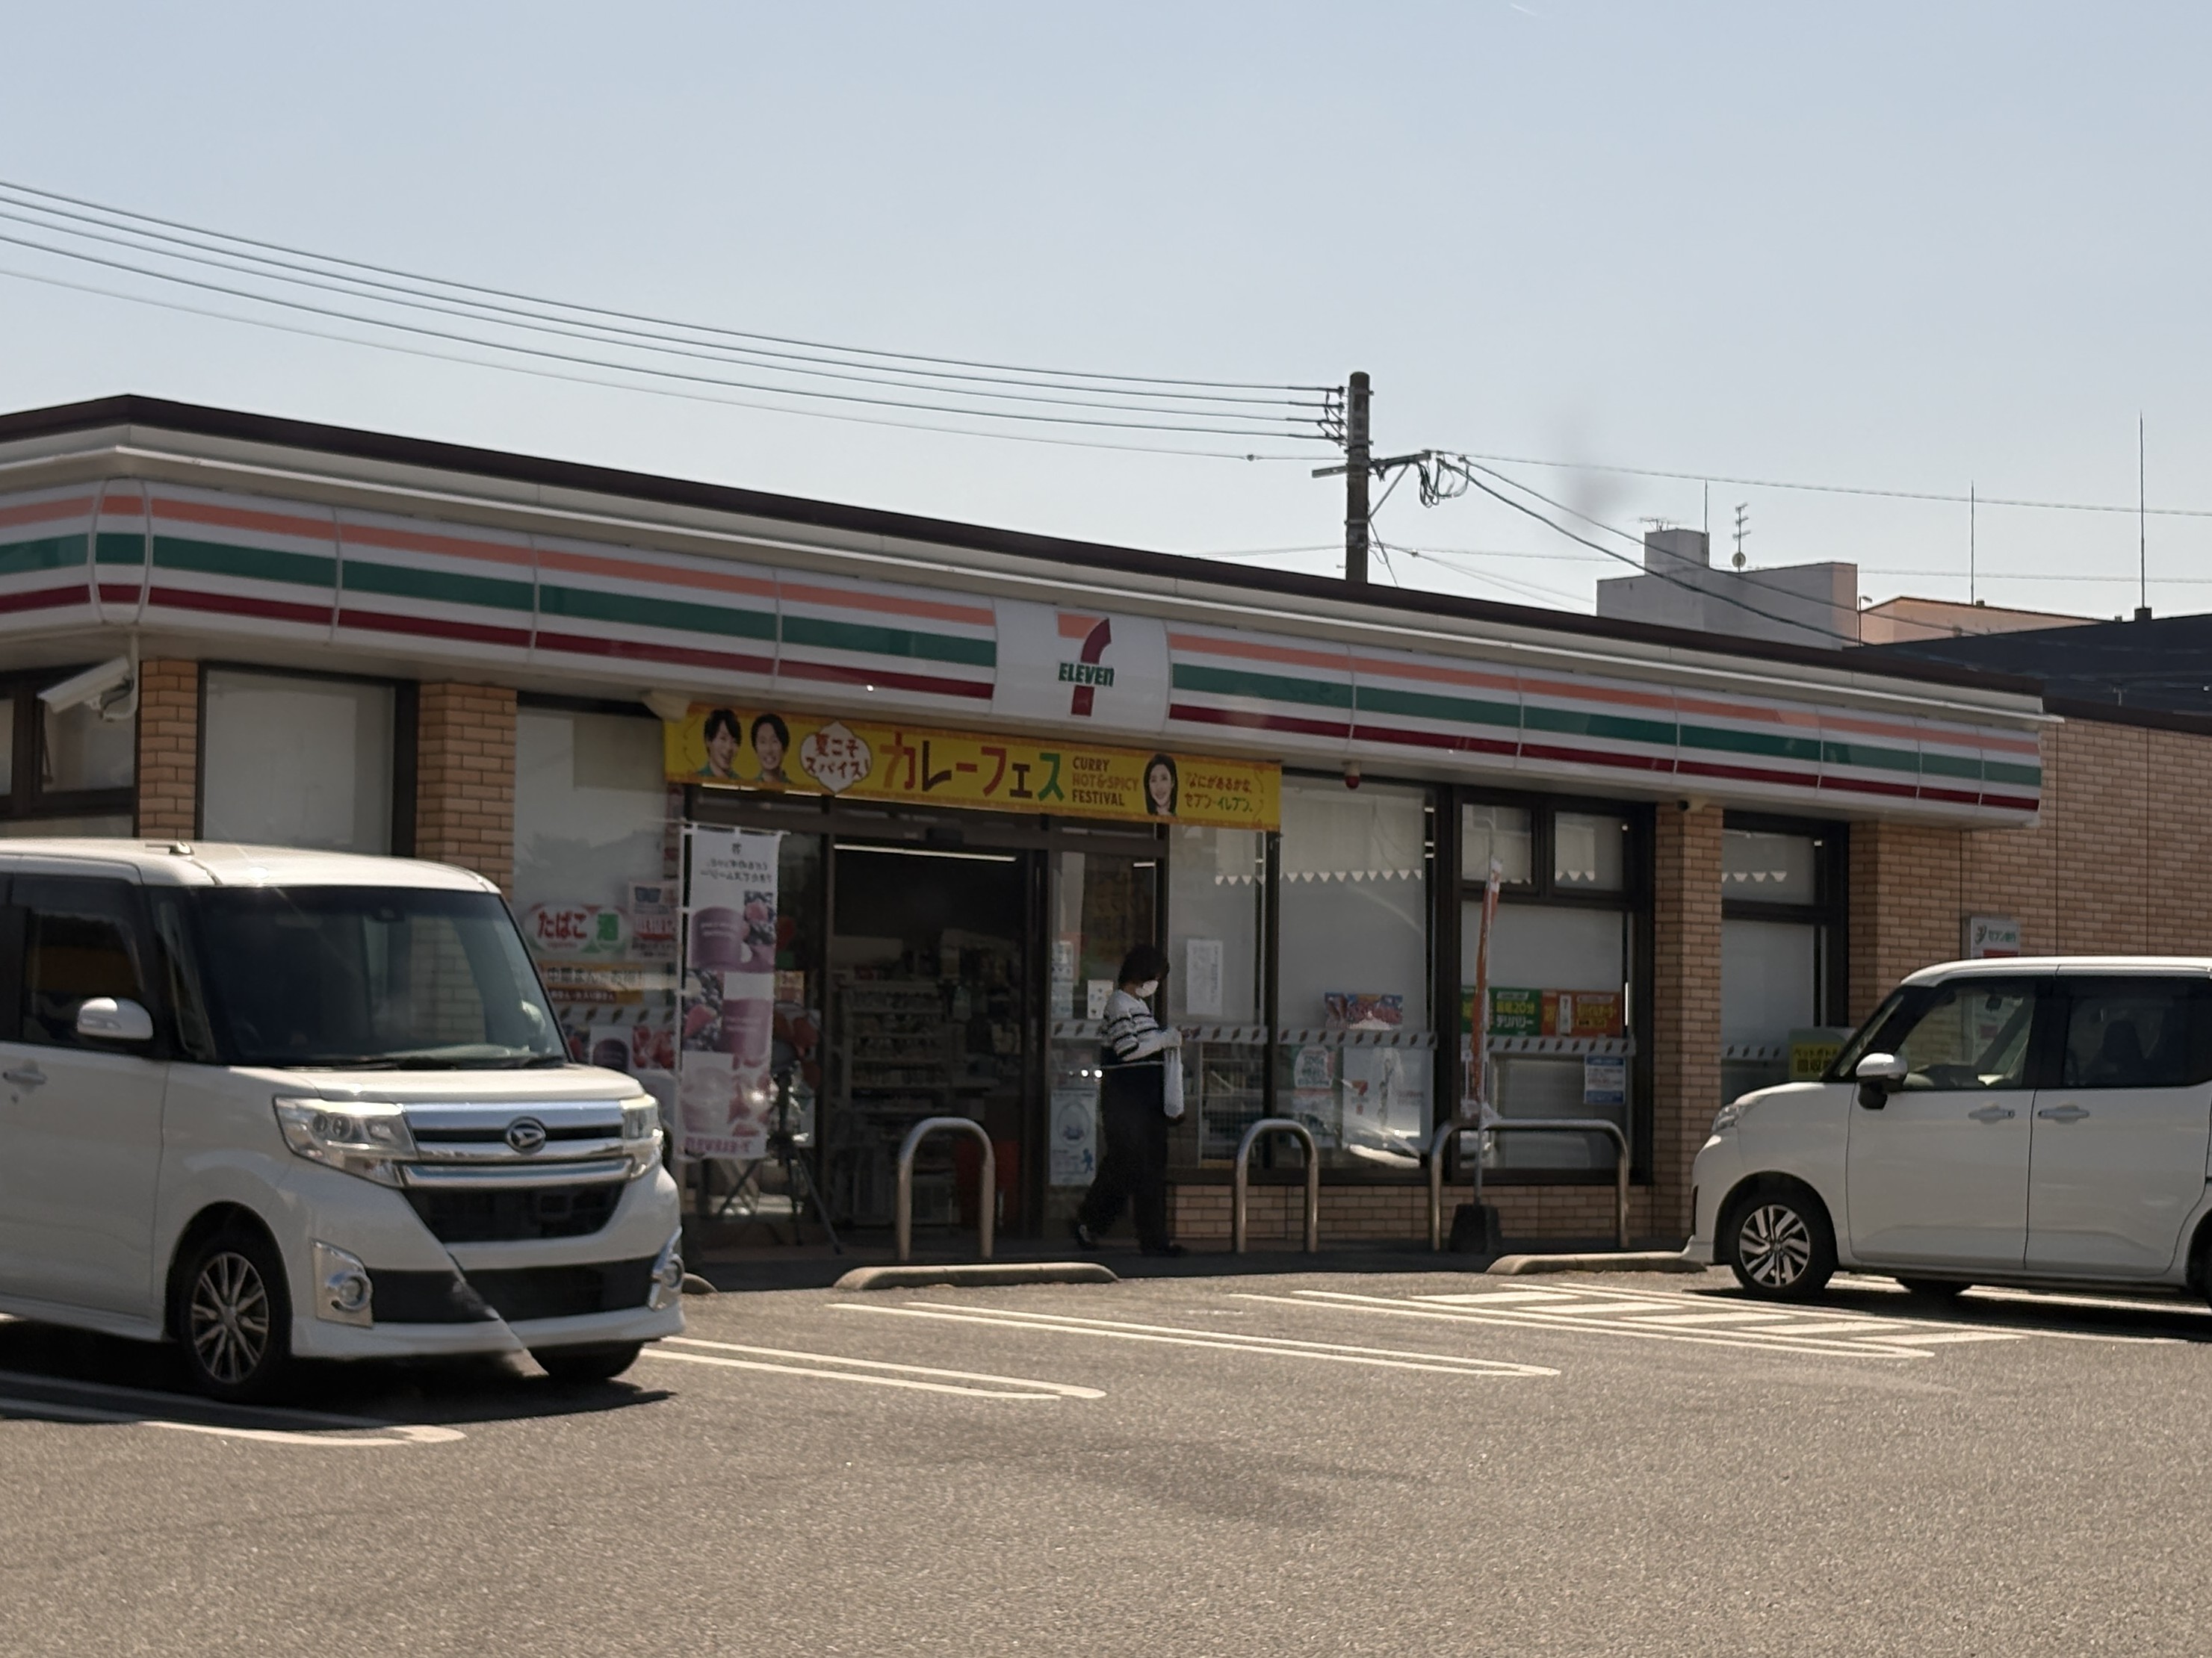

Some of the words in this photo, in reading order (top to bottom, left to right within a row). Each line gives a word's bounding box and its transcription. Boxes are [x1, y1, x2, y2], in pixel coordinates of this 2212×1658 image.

[815, 733, 859, 757] 夏こそ
[879, 730, 1065, 802] カレーフェス
[1073, 756, 1110, 772] CURRY
[1073, 772, 1138, 791] HOT&SPICY
[1073, 789, 1125, 806] FESTIVAL
[537, 910, 587, 939] たばこ
